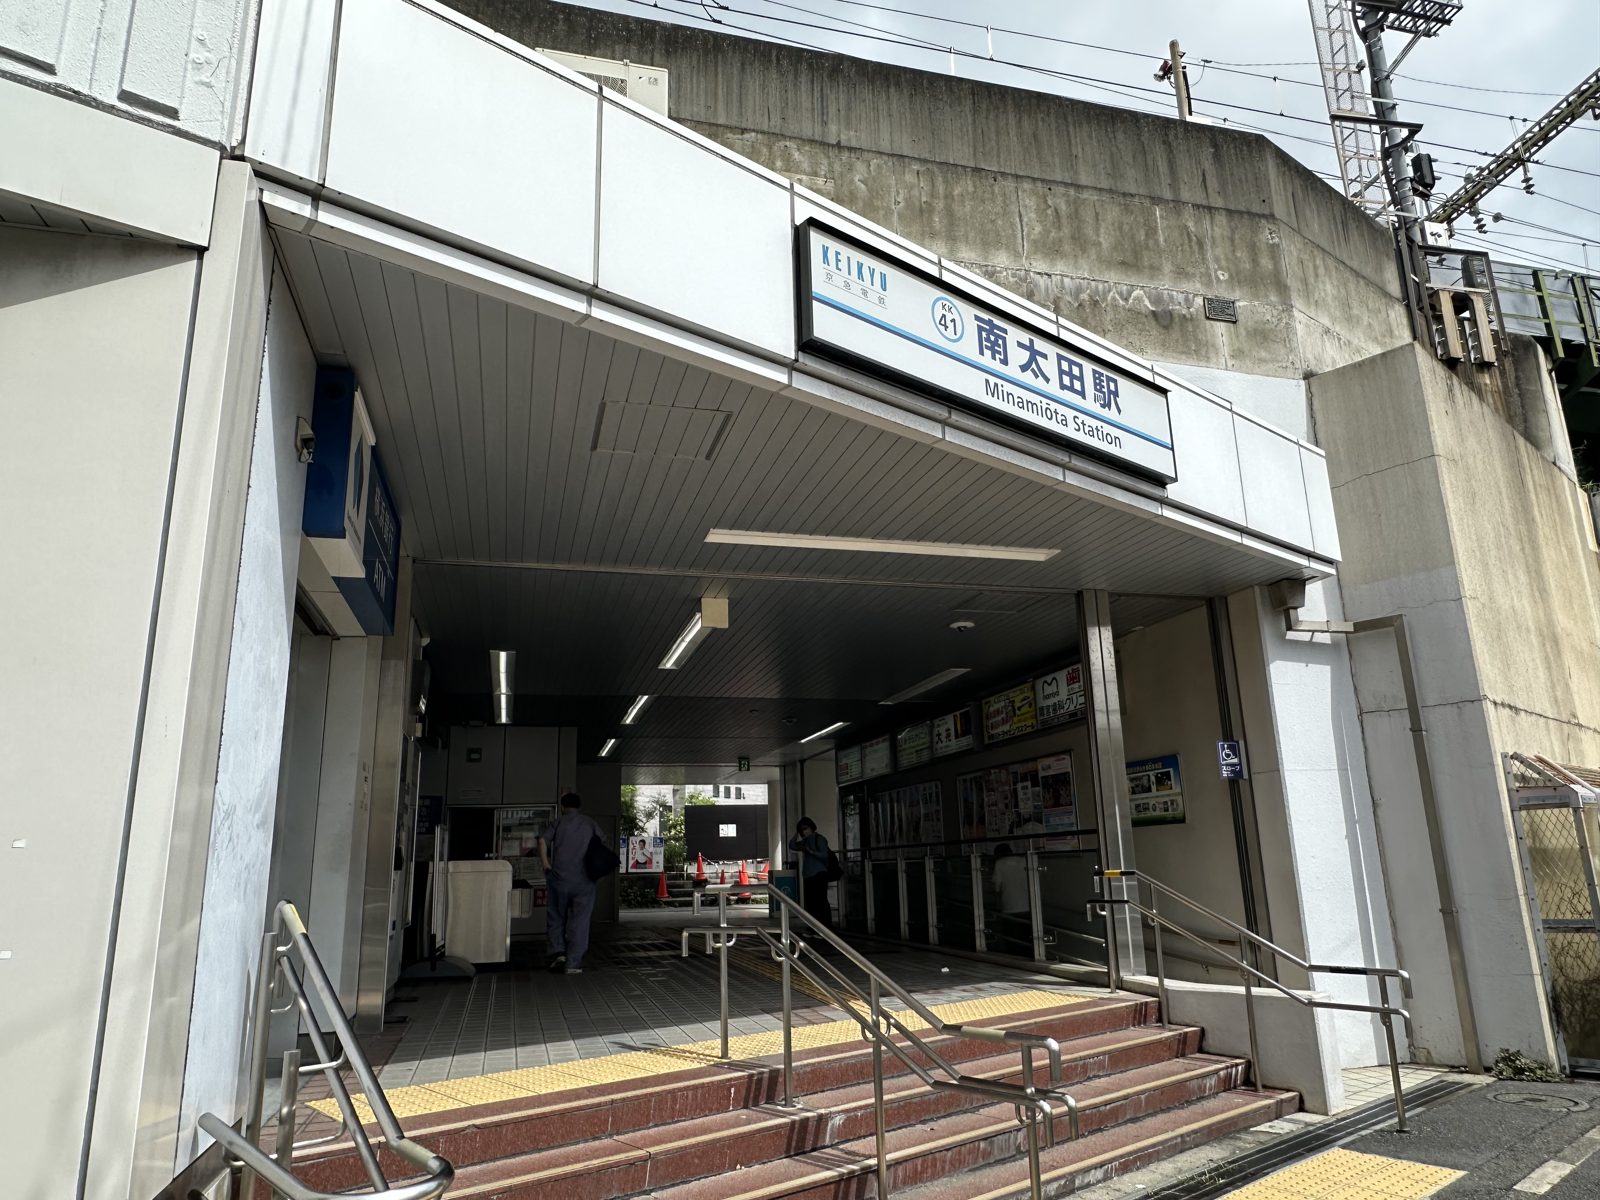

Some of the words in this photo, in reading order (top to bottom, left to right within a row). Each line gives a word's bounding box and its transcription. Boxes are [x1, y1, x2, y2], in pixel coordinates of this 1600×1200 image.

[822, 244, 888, 292] KEIKYU
[824, 272, 887, 307] 京急電鉄
[938, 313, 958, 336] 41
[941, 302, 954, 315] KK
[974, 313, 1122, 416] 南太田駅
[984, 378, 1069, 428] Minamiōta
[1073, 415, 1122, 449] Station
[373, 557, 387, 603] ATM
